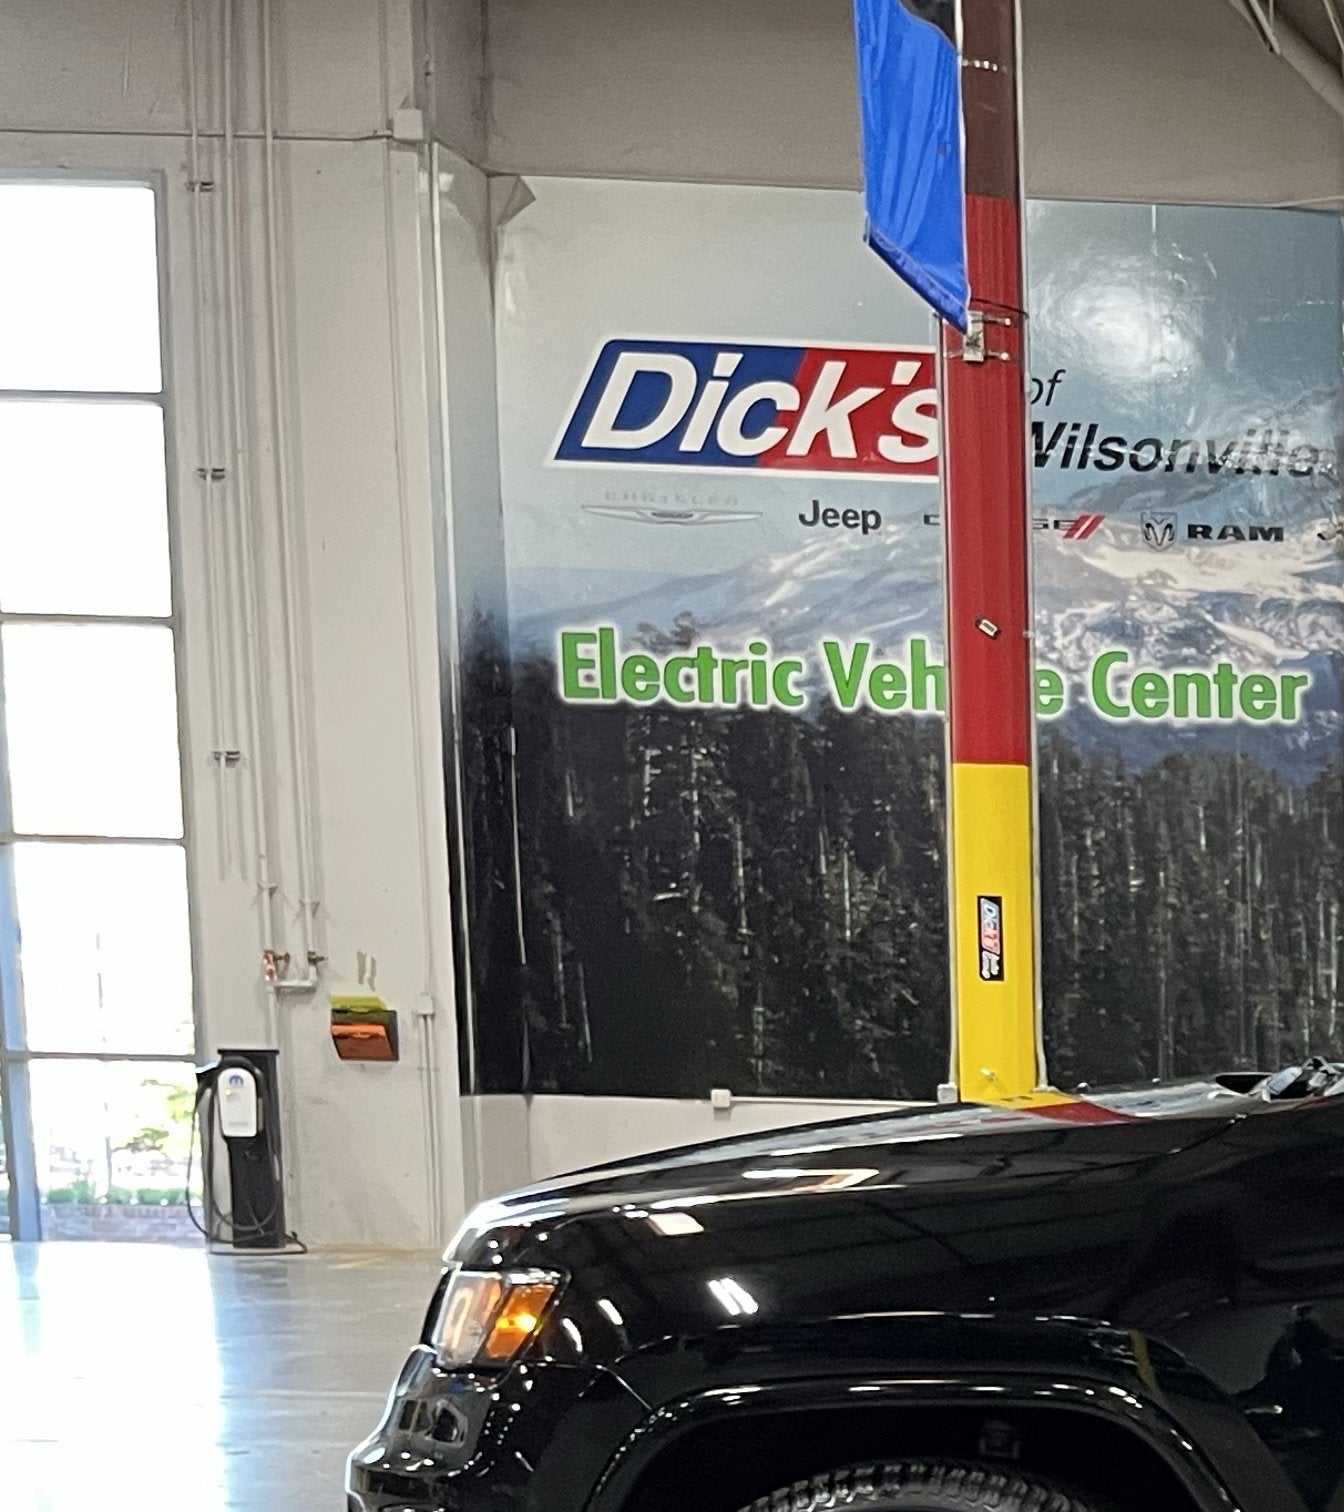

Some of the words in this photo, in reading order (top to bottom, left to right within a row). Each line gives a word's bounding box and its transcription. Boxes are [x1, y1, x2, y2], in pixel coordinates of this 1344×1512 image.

[581, 352, 939, 463] Dick's
[799, 500, 882, 535] Jeep
[1187, 523, 1284, 543] RAM
[561, 627, 805, 707] Electric
[823, 639, 1065, 716] Vehe
[1092, 650, 1308, 721] Center
